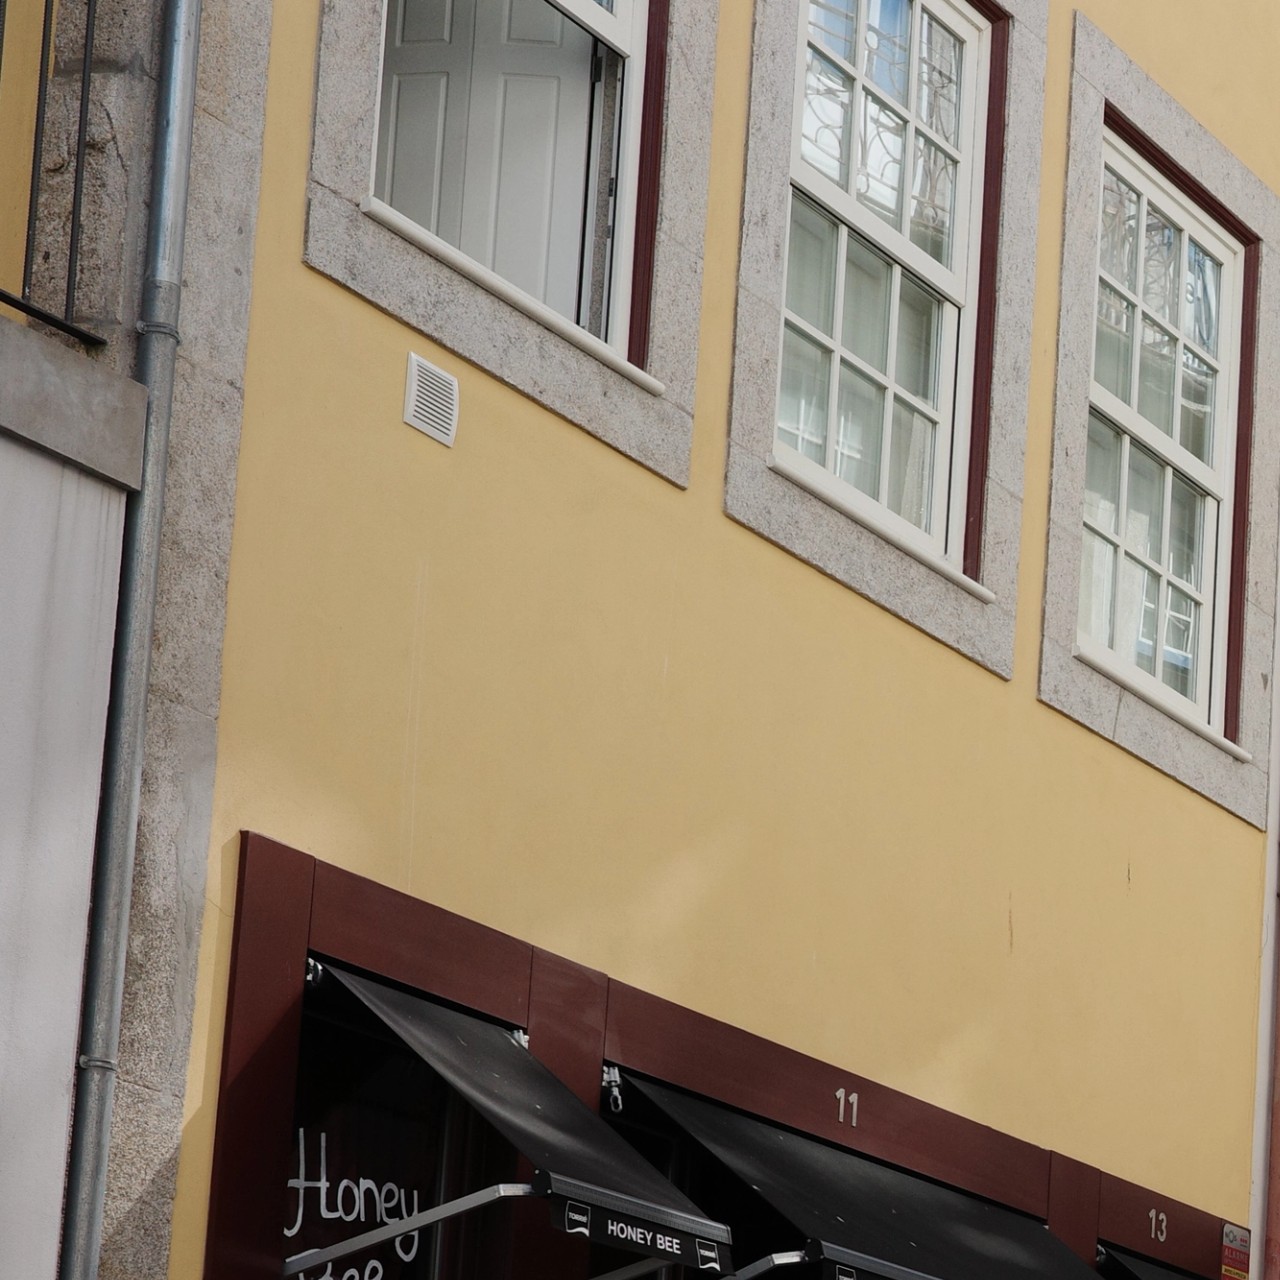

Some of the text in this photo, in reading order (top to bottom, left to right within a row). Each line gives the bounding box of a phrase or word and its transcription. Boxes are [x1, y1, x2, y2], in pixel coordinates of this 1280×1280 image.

[834, 1087, 859, 1127] 11
[284, 1128, 420, 1262] Honey
[607, 1219, 682, 1255] HONEY BEE
[1149, 1208, 1168, 1243] 13
